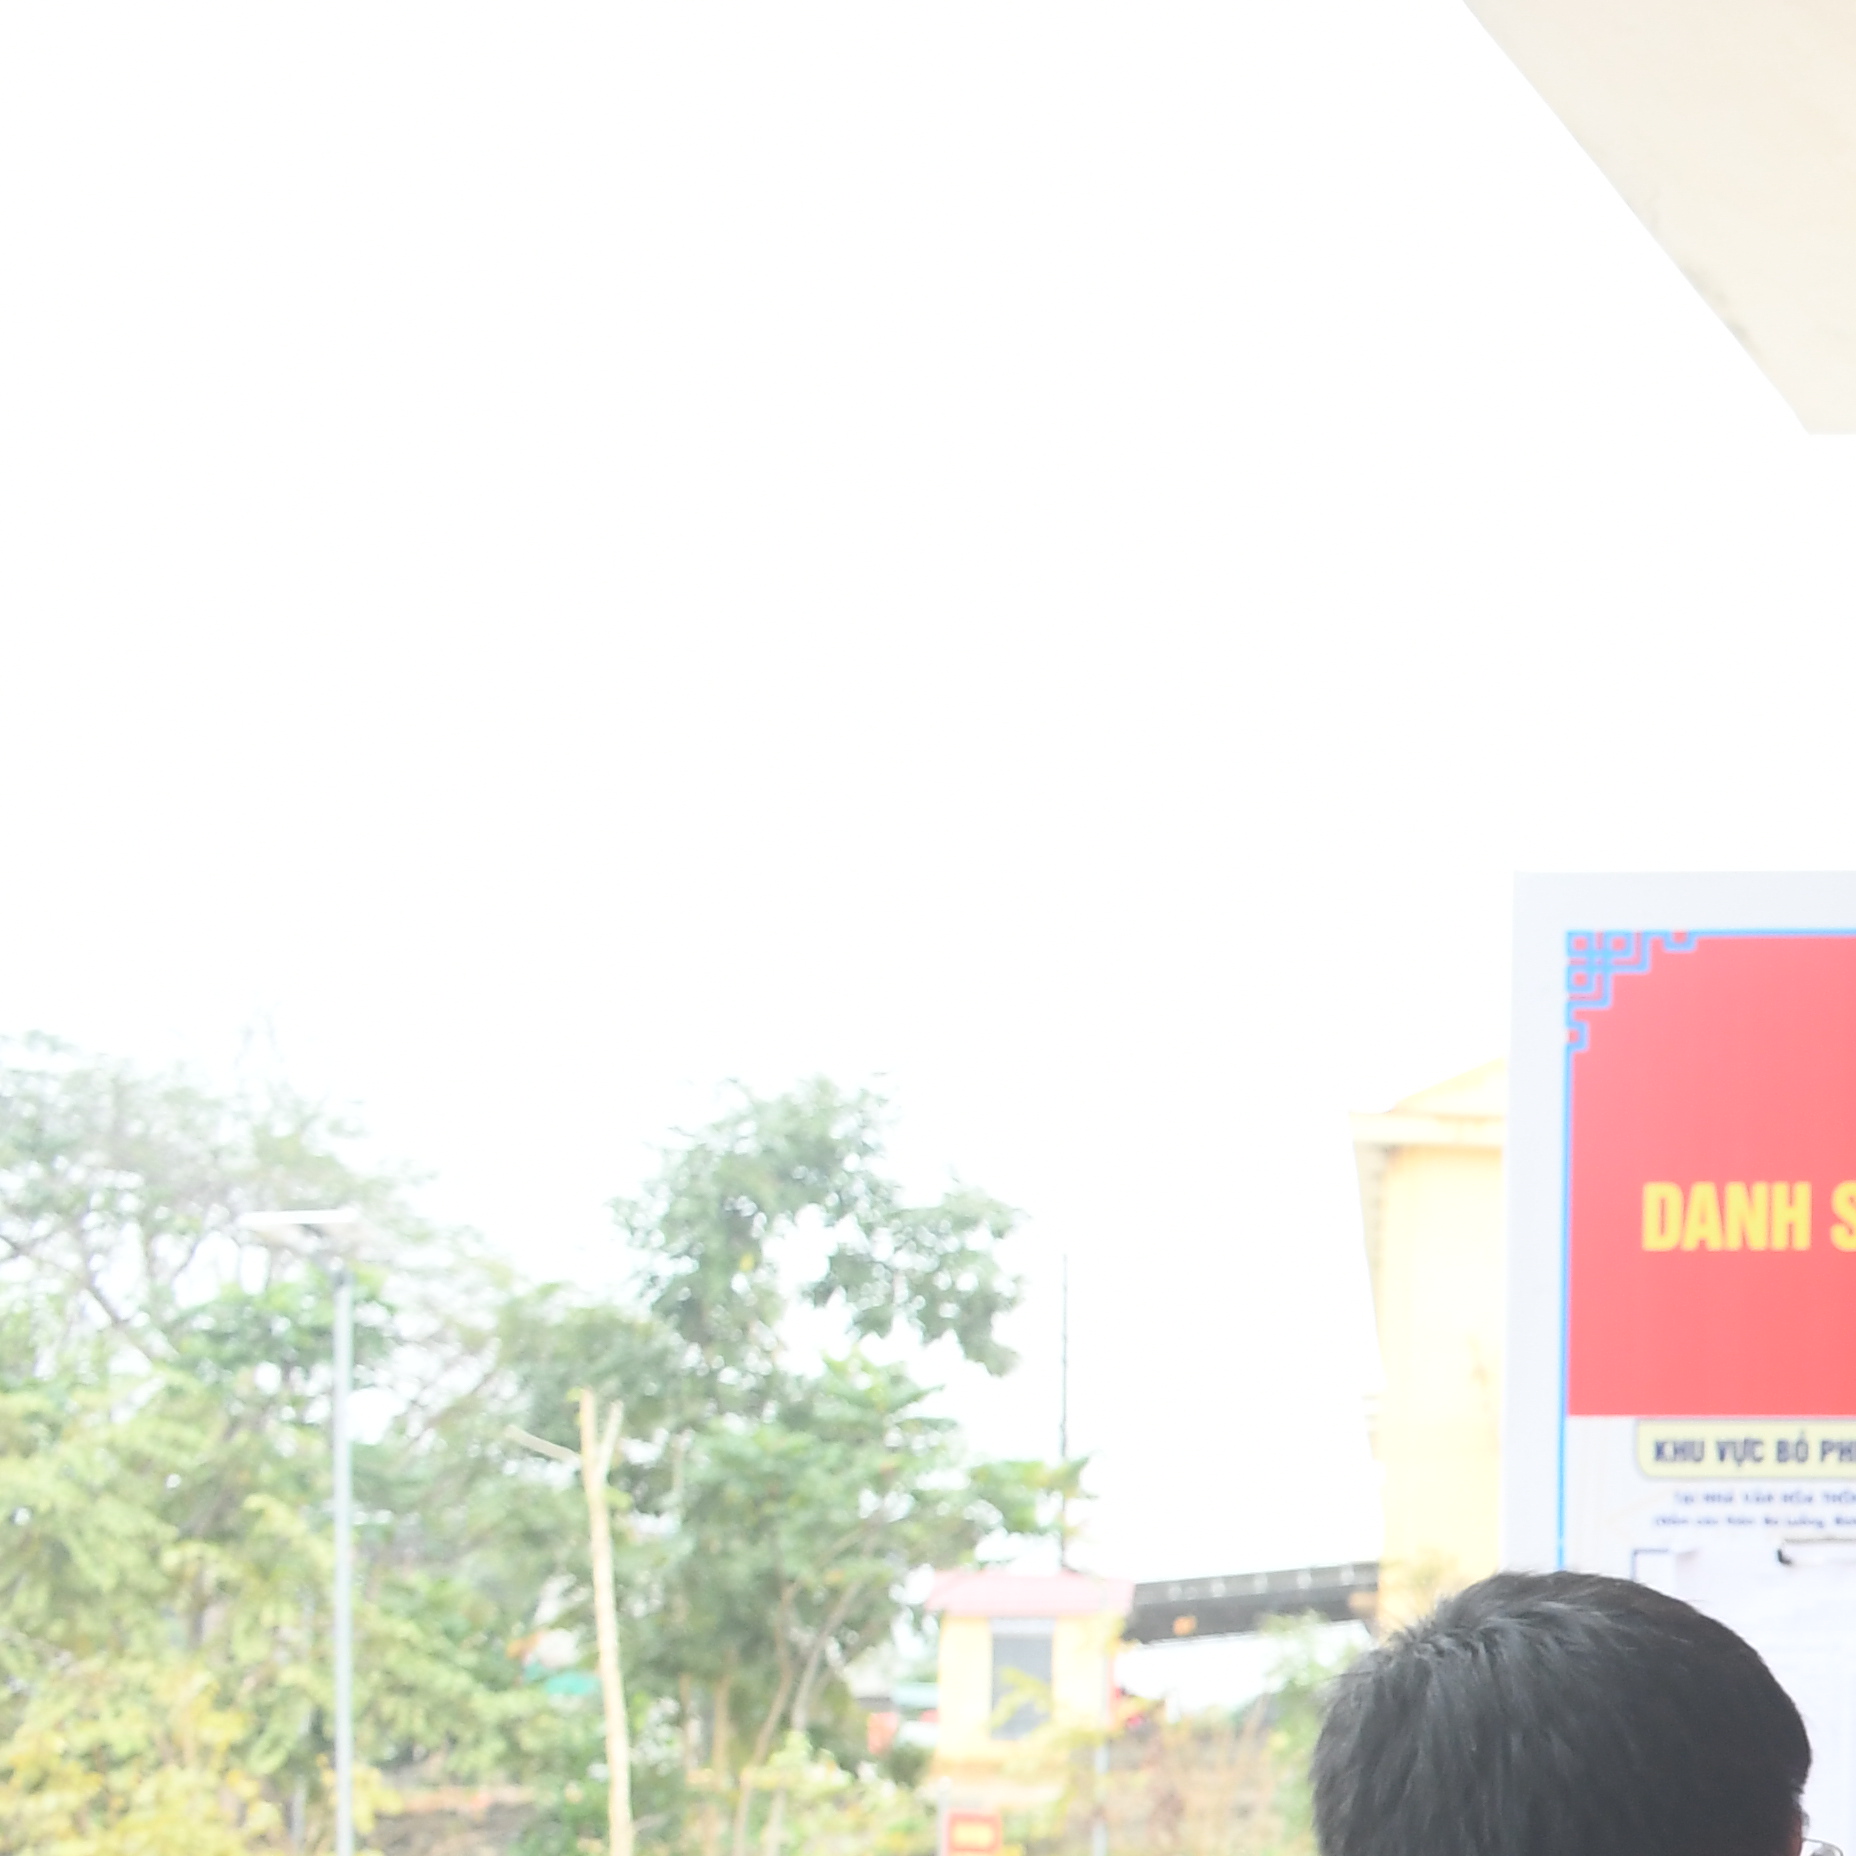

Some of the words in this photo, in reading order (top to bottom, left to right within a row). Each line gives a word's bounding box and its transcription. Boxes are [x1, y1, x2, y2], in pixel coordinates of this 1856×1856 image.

[1644, 1184, 1810, 1249] DANH
[1653, 1440, 1705, 1464] KHU
[1716, 1438, 1764, 1467] VỰC
